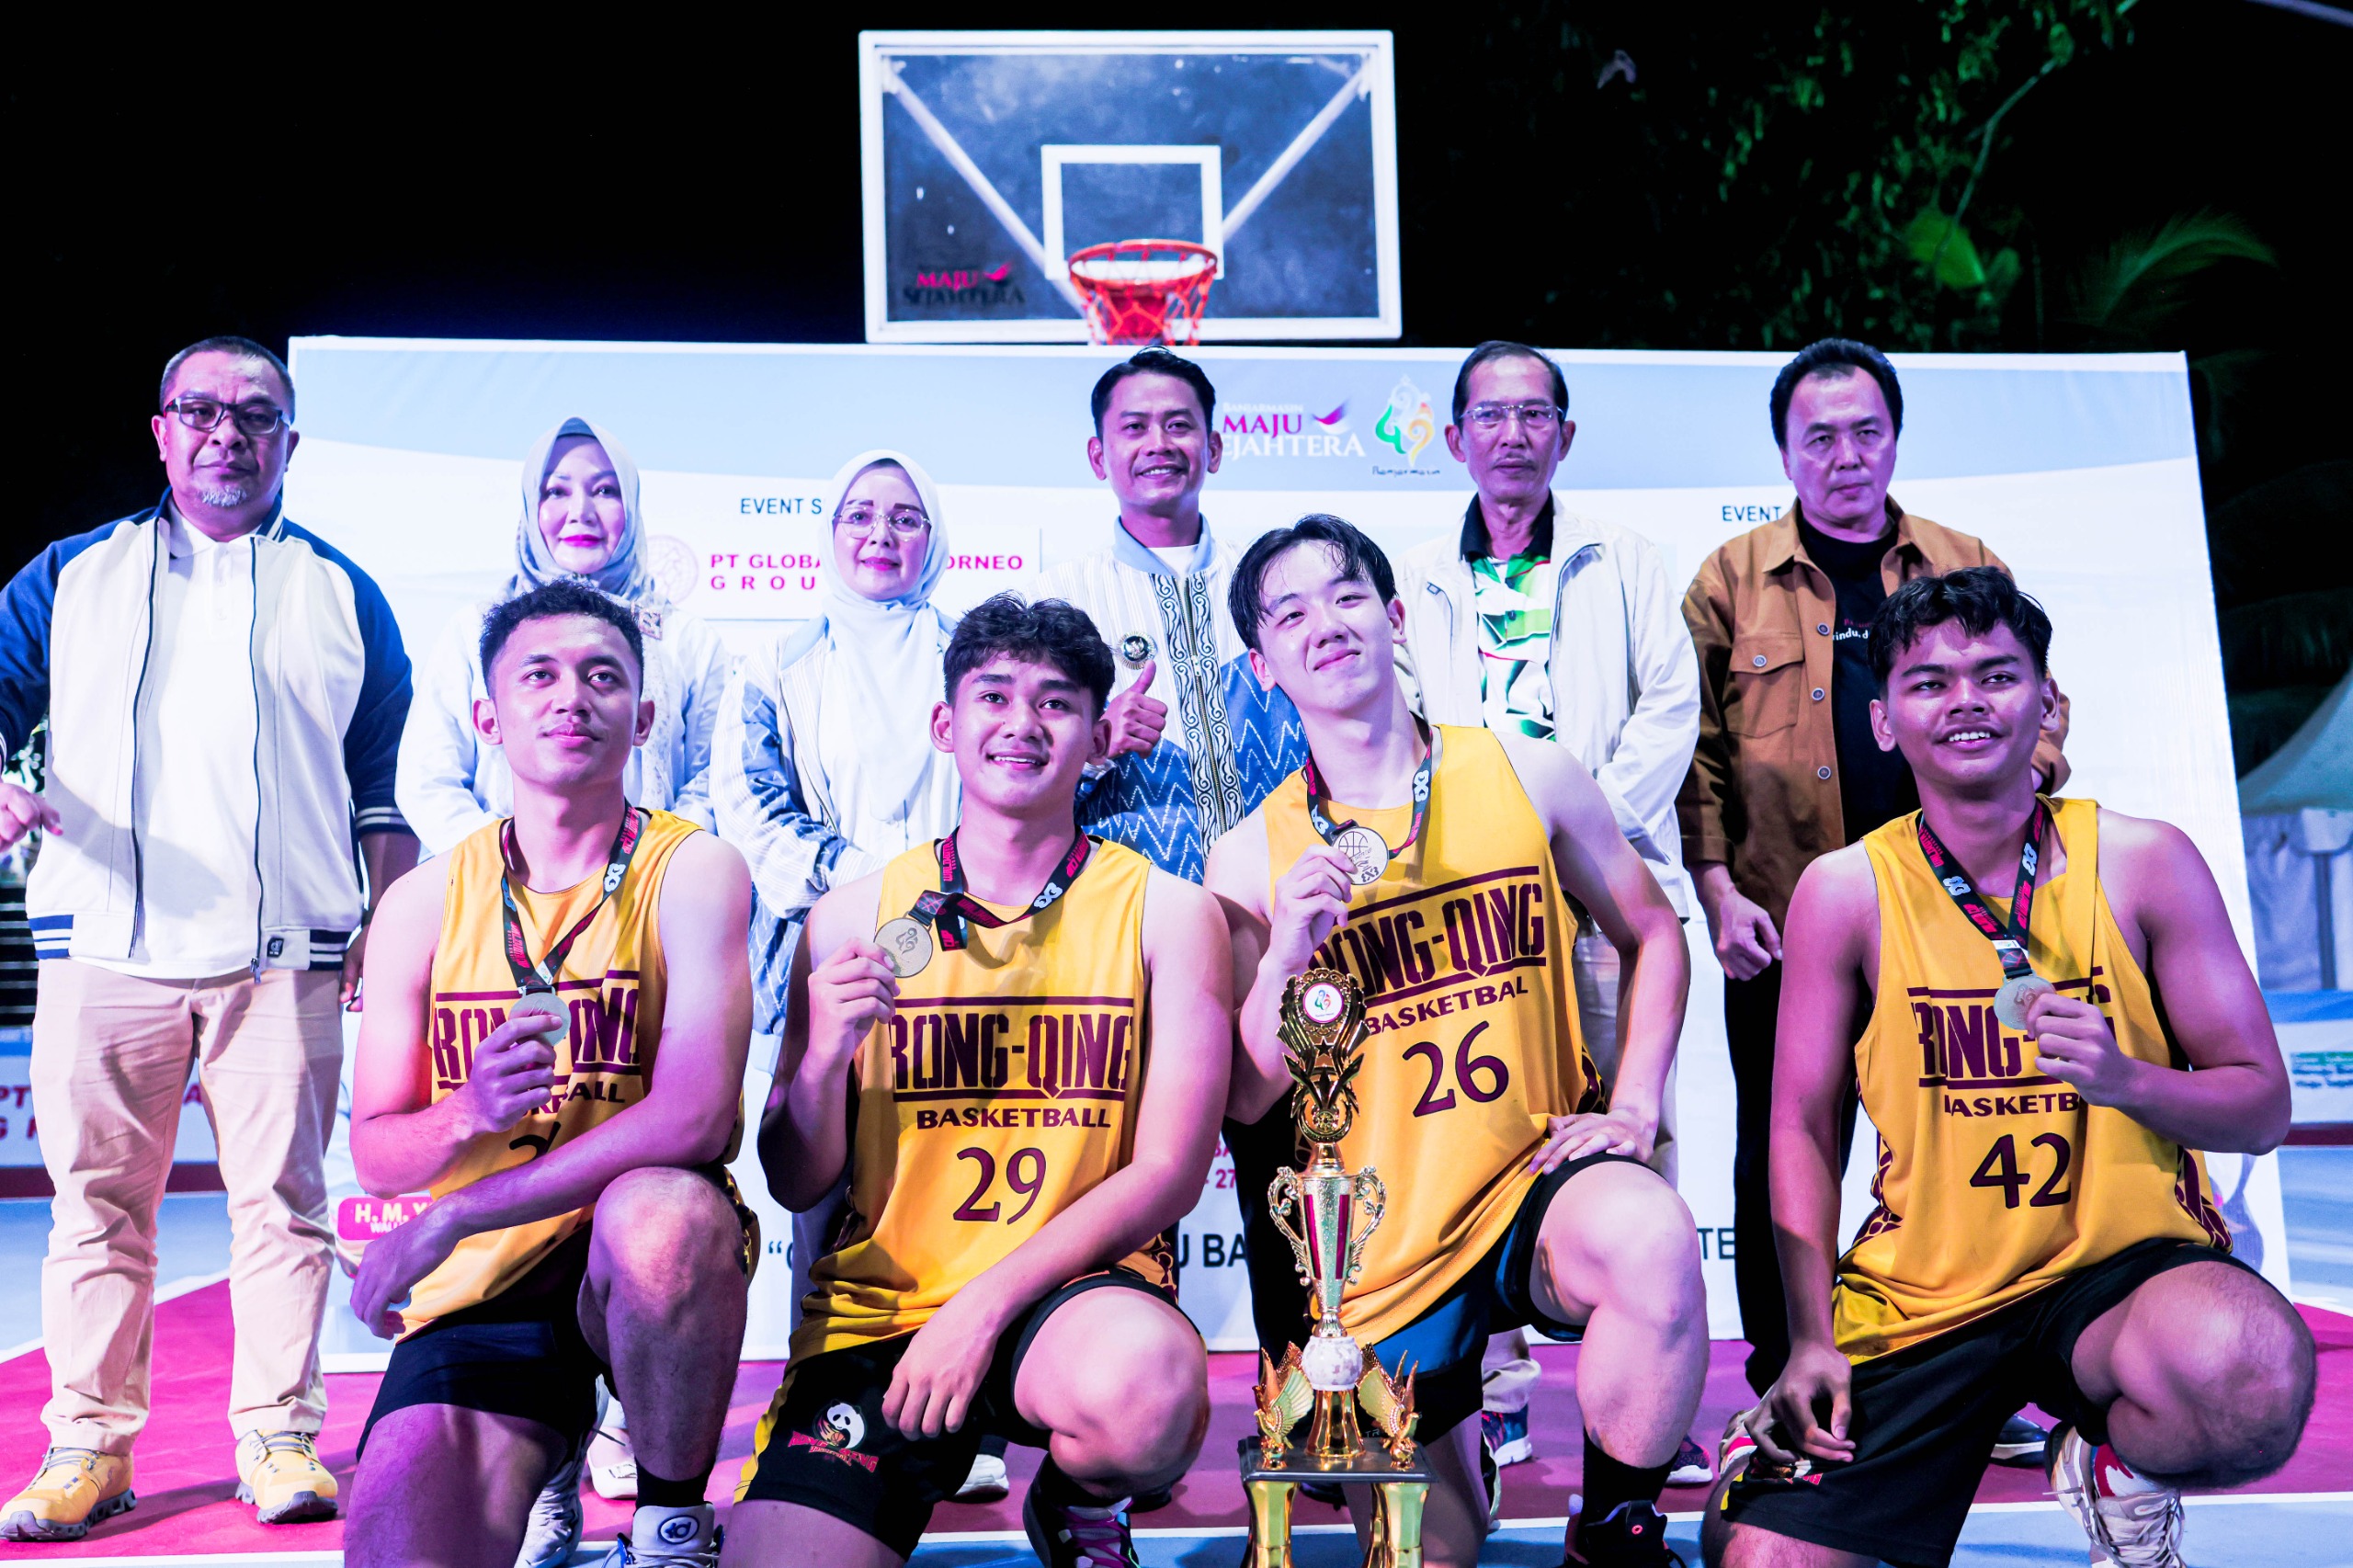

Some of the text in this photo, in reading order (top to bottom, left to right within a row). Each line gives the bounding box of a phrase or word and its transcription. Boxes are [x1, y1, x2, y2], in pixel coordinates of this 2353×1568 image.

[917, 270, 979, 292] MAJU
[1222, 414, 1302, 438] MAJU
[1221, 433, 1367, 461] EJAHTERA
[741, 497, 804, 515] EVENT
[1722, 505, 1782, 522] EVENT
[710, 553, 740, 569] PT
[946, 554, 1023, 570] ORNEO
[1403, 1020, 1509, 1118] 26
[916, 1108, 1111, 1130] BASKETBALL
[1970, 1132, 2072, 1209] 42
[952, 1147, 1047, 1226] 29
